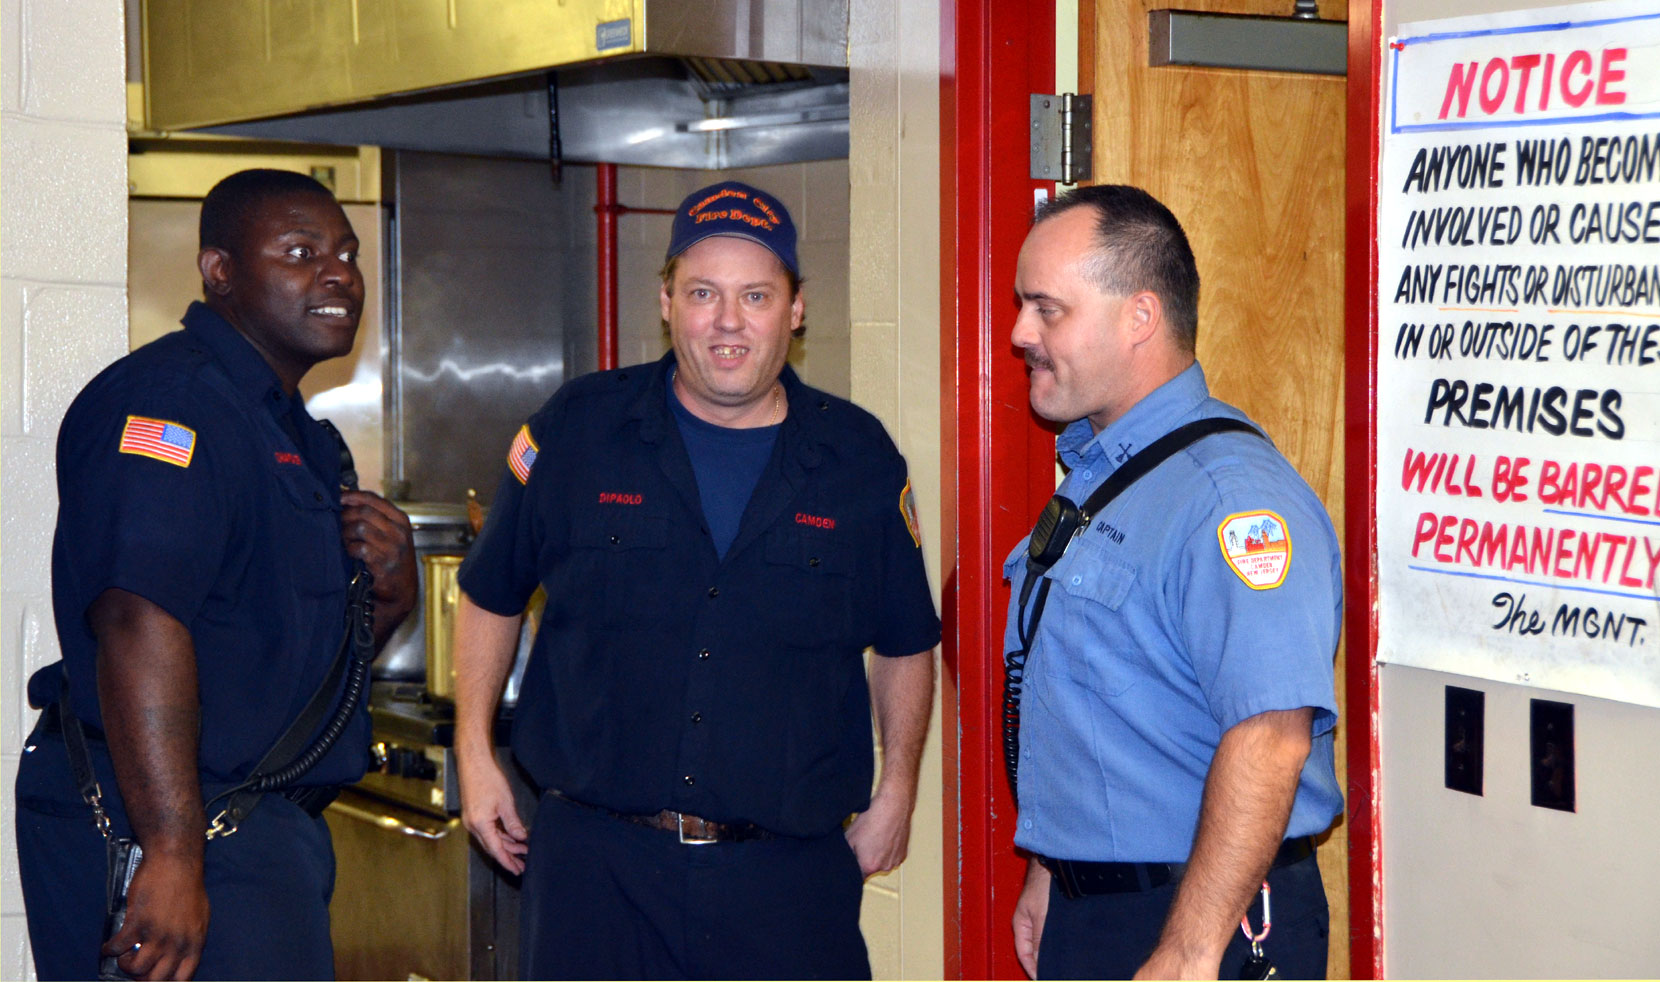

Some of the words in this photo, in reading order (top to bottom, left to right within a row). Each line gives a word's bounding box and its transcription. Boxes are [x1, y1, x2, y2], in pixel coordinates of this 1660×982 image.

[1438, 48, 1628, 120] NOTICE
[1402, 142, 1507, 194] ANYONE
[1516, 137, 1571, 186] WHO
[1402, 205, 1522, 251] INVOLVED
[1529, 203, 1561, 245] OR
[1569, 201, 1660, 245] CAUSE
[1394, 264, 1442, 304] ANY
[1443, 264, 1522, 306] FIGHTS
[1524, 264, 1549, 305] OR
[1394, 323, 1425, 360] IN
[1428, 323, 1455, 361] OR
[1460, 320, 1555, 363] OUTSIDE
[1563, 324, 1602, 361] OF
[1605, 323, 1660, 366] THE
[1424, 378, 1625, 440] PREMISES
[599, 492, 643, 505] DIPAOLO
[1401, 448, 1482, 498] WILL
[1491, 456, 1531, 504] BE
[795, 512, 836, 529] CAMDEN
[1096, 520, 1126, 546] CAPTAIN
[1411, 512, 1660, 590] PERMANENTLY
[1491, 592, 1546, 636] The
[1551, 603, 1647, 648] MGNT.
